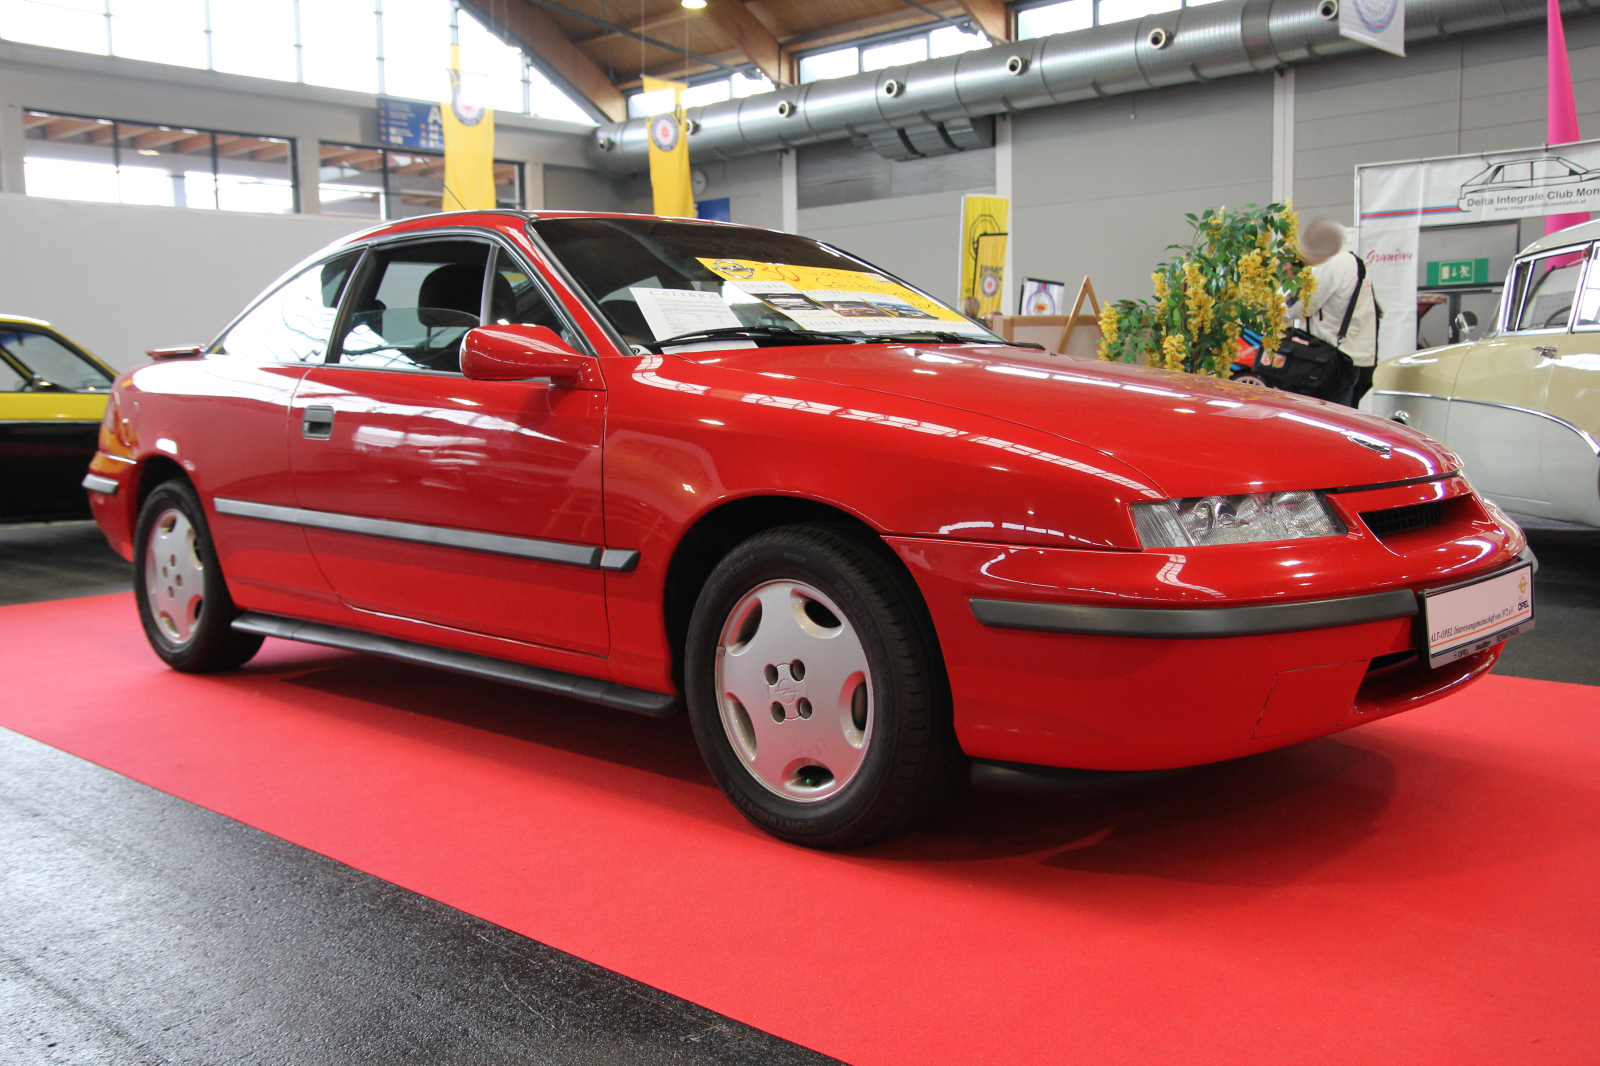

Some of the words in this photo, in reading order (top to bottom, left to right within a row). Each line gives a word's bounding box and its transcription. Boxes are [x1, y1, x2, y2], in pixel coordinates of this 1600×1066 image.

[1466, 197, 1494, 207] Delta
[1496, 192, 1544, 205] Integrale
[1547, 189, 1573, 200] Club
[754, 263, 801, 282] 30
[649, 289, 719, 300] CALIBRA
[1517, 600, 1529, 611] OPEL
[728, 780, 818, 834] CONTINENTAL
